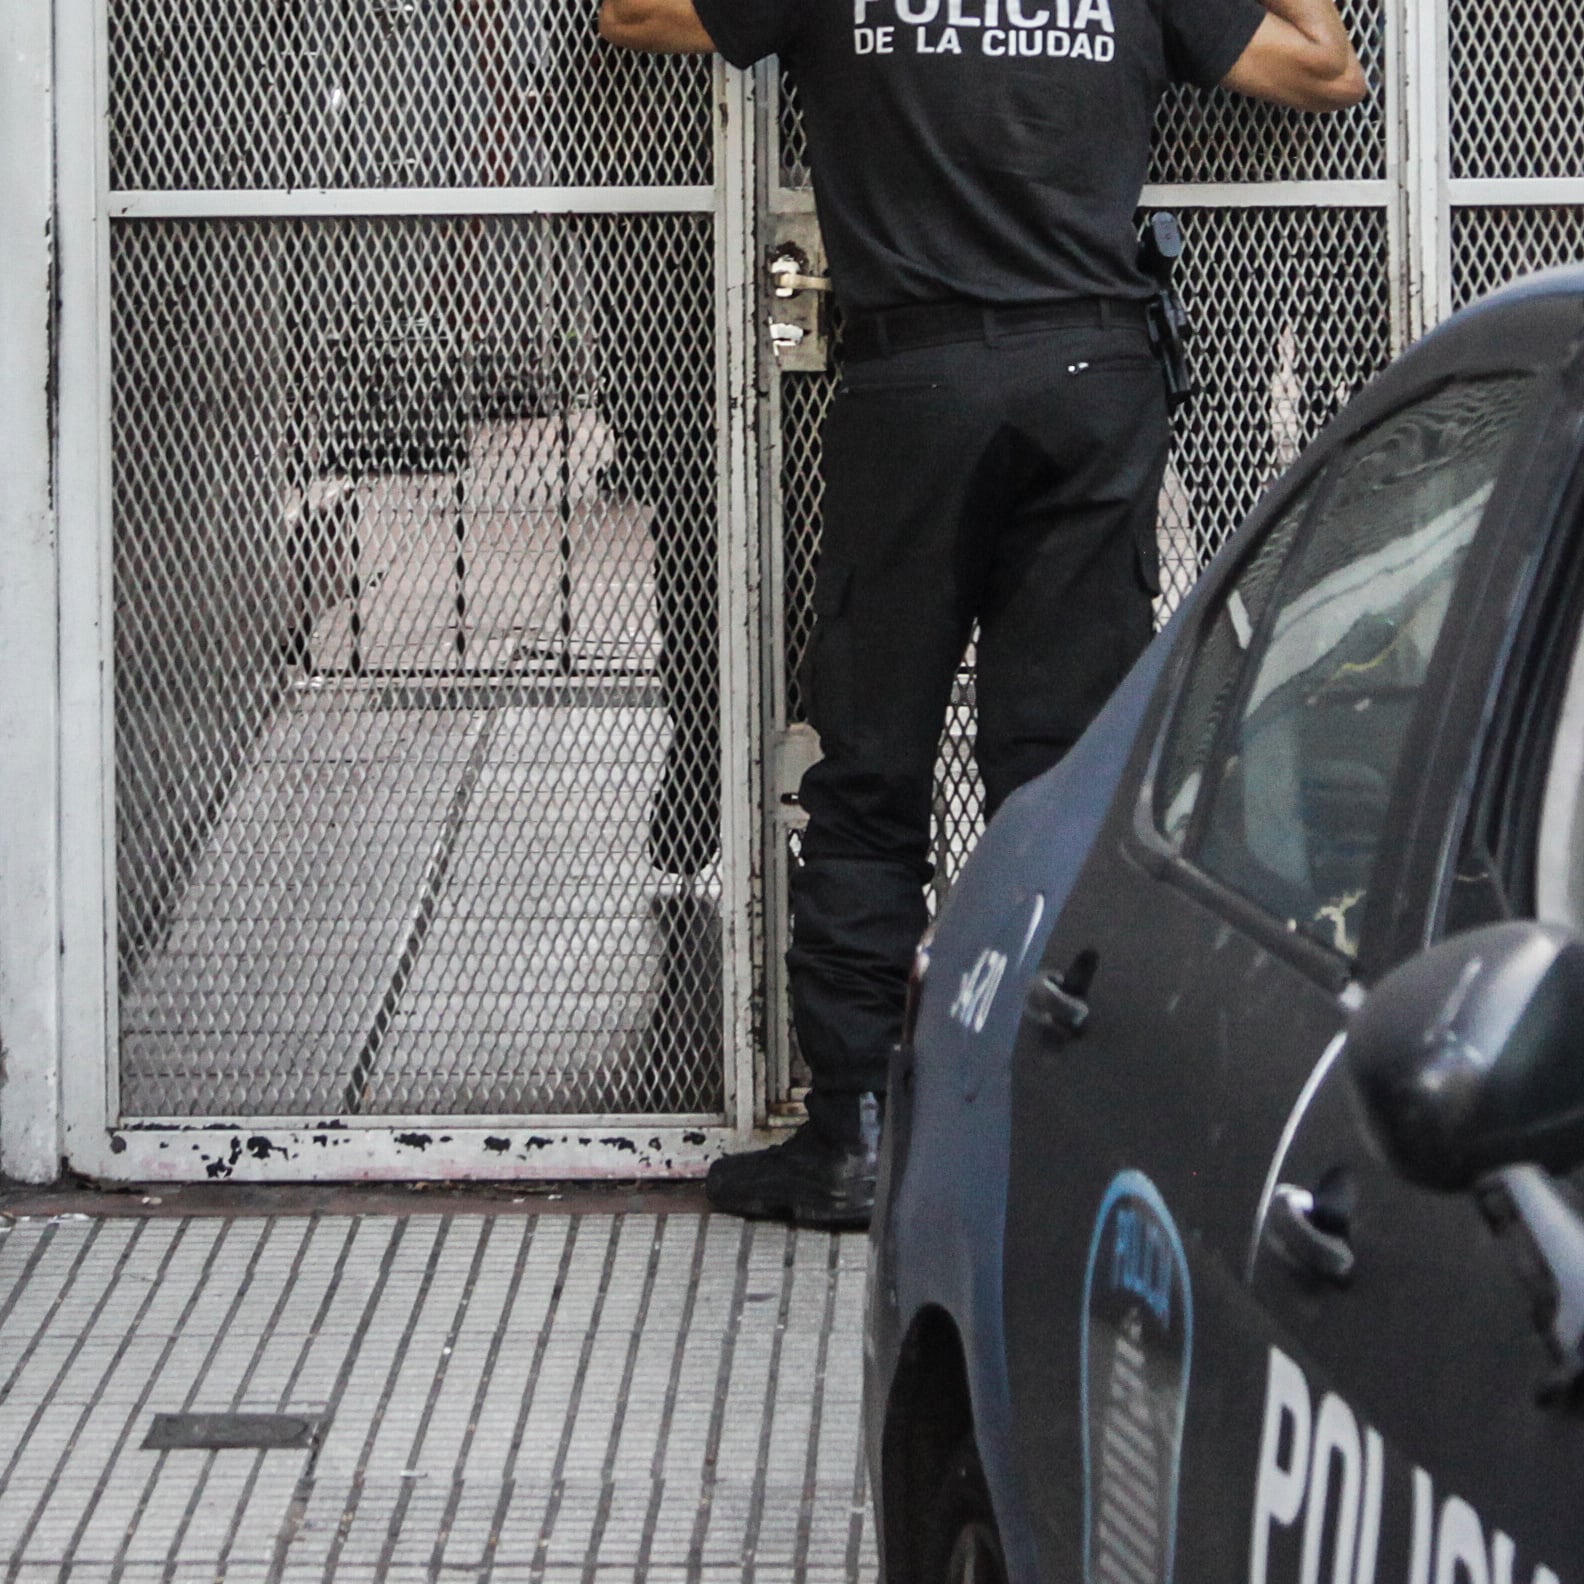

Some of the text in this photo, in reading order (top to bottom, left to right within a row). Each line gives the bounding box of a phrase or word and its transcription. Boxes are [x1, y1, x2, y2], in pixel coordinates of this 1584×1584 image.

[854, 26, 1115, 62] DE LA CIUDAD
[1249, 1343, 1563, 1584] POLI
